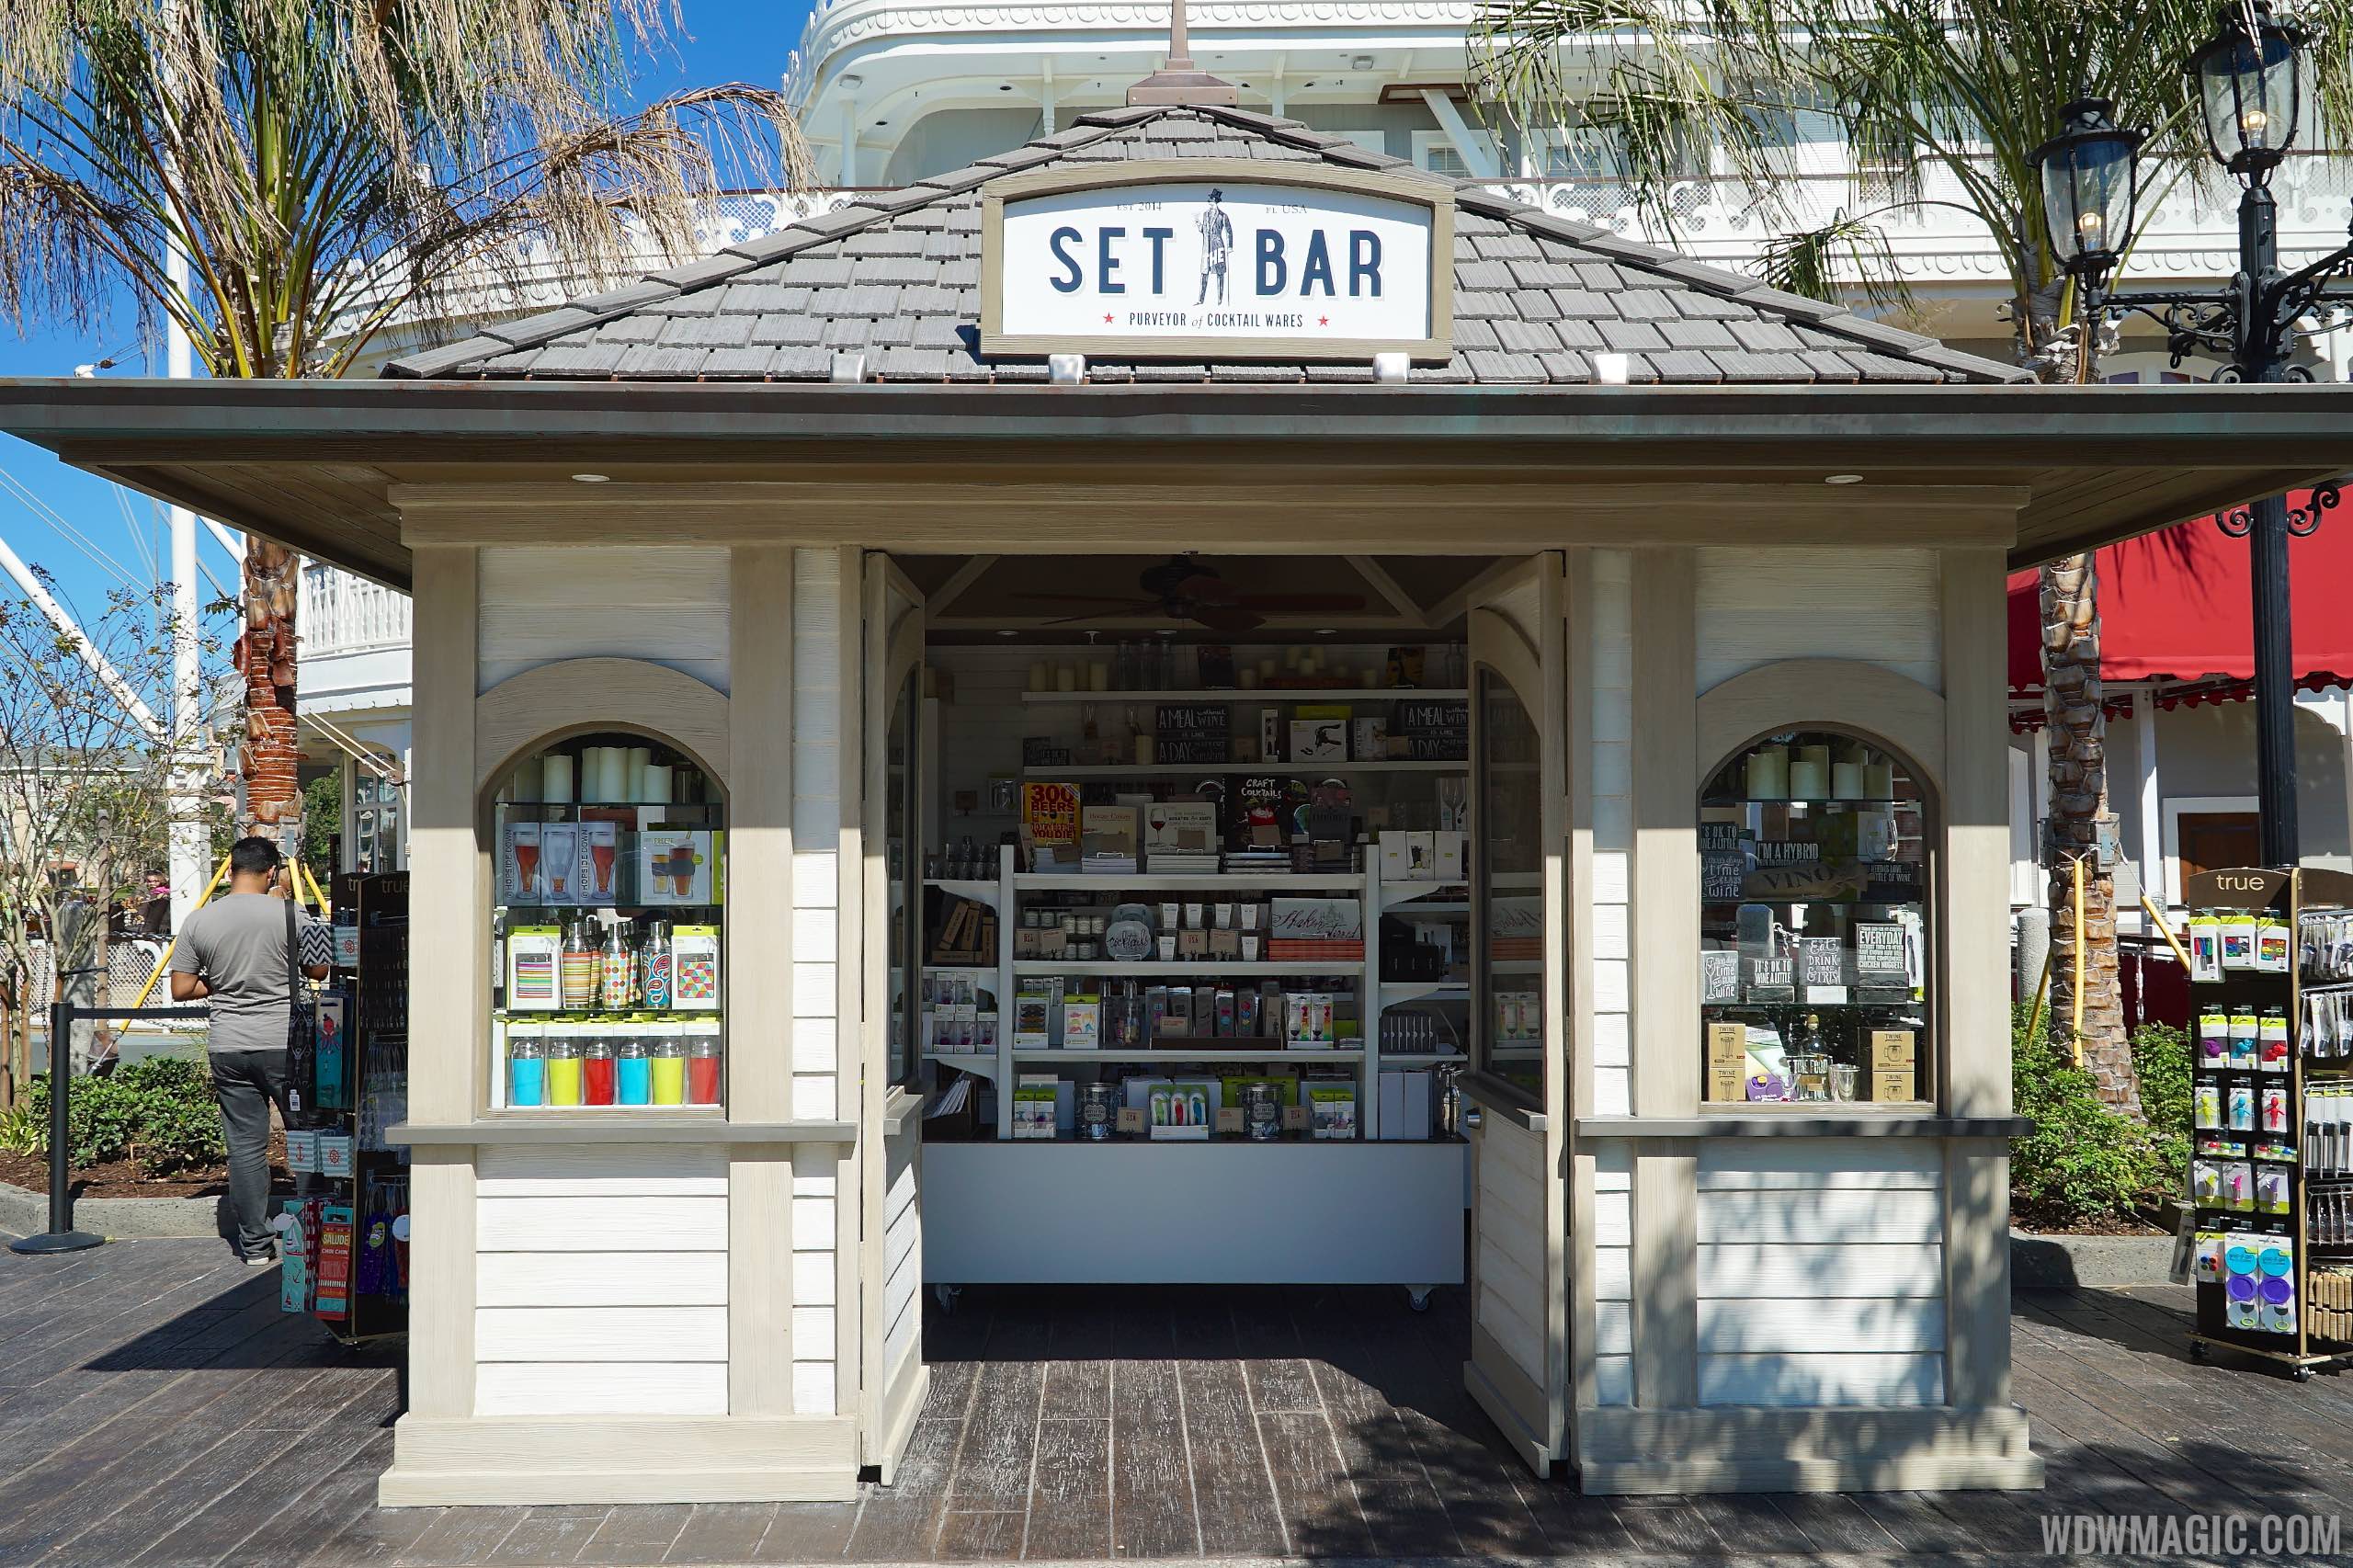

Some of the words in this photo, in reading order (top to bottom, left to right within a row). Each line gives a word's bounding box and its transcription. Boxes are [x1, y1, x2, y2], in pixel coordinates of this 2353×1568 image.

[1138, 201, 1162, 211] 2014
[1281, 204, 1308, 215] USA
[1050, 226, 1174, 295] SET
[1203, 247, 1225, 267] THE
[1256, 229, 1382, 297] BAR
[1129, 312, 1187, 326] PURVEYOR
[1191, 314, 1203, 329] of
[1207, 313, 1261, 327] COCKTAIL
[1265, 314, 1303, 328] WARES
[1159, 709, 1166, 728] A
[1168, 709, 1198, 728] MEAL
[1198, 715, 1228, 727] WINE
[1417, 706, 1447, 726] MEAL
[1447, 713, 1468, 723] WIN
[1169, 742, 1191, 762] DAY
[1418, 738, 1441, 758] DAY
[1245, 778, 1276, 789] CRAFT
[1030, 785, 1074, 802] 300
[1241, 788, 1281, 799] COCKTAILS
[1031, 801, 1074, 812] BEERS
[1033, 830, 1053, 838] YOU
[1713, 826, 1722, 837] OK
[1727, 826, 1737, 837] TO
[506, 829, 514, 853] DOWN
[1775, 843, 1781, 859] A
[1784, 843, 1819, 859] HYBRID
[505, 853, 513, 891] HOPSIDE
[1711, 864, 1739, 876] time
[1763, 864, 1833, 890] VINO
[1896, 873, 1911, 882] WINE
[2216, 874, 2265, 892] true
[1709, 885, 1740, 897] wine
[1859, 931, 1904, 945] EVERYDAY
[1809, 939, 1837, 954] Eat
[1755, 960, 1768, 972] IT'S
[1771, 960, 1779, 972] OK
[1782, 960, 1791, 972] TO
[1809, 955, 1838, 966] DRINK
[1716, 963, 1735, 976] time
[1807, 966, 1816, 982] &
[1755, 972, 1769, 984] WINE
[1775, 972, 1791, 984] LITTLE
[1714, 985, 1735, 998] wine
[323, 1234, 349, 1245] SALUDE
